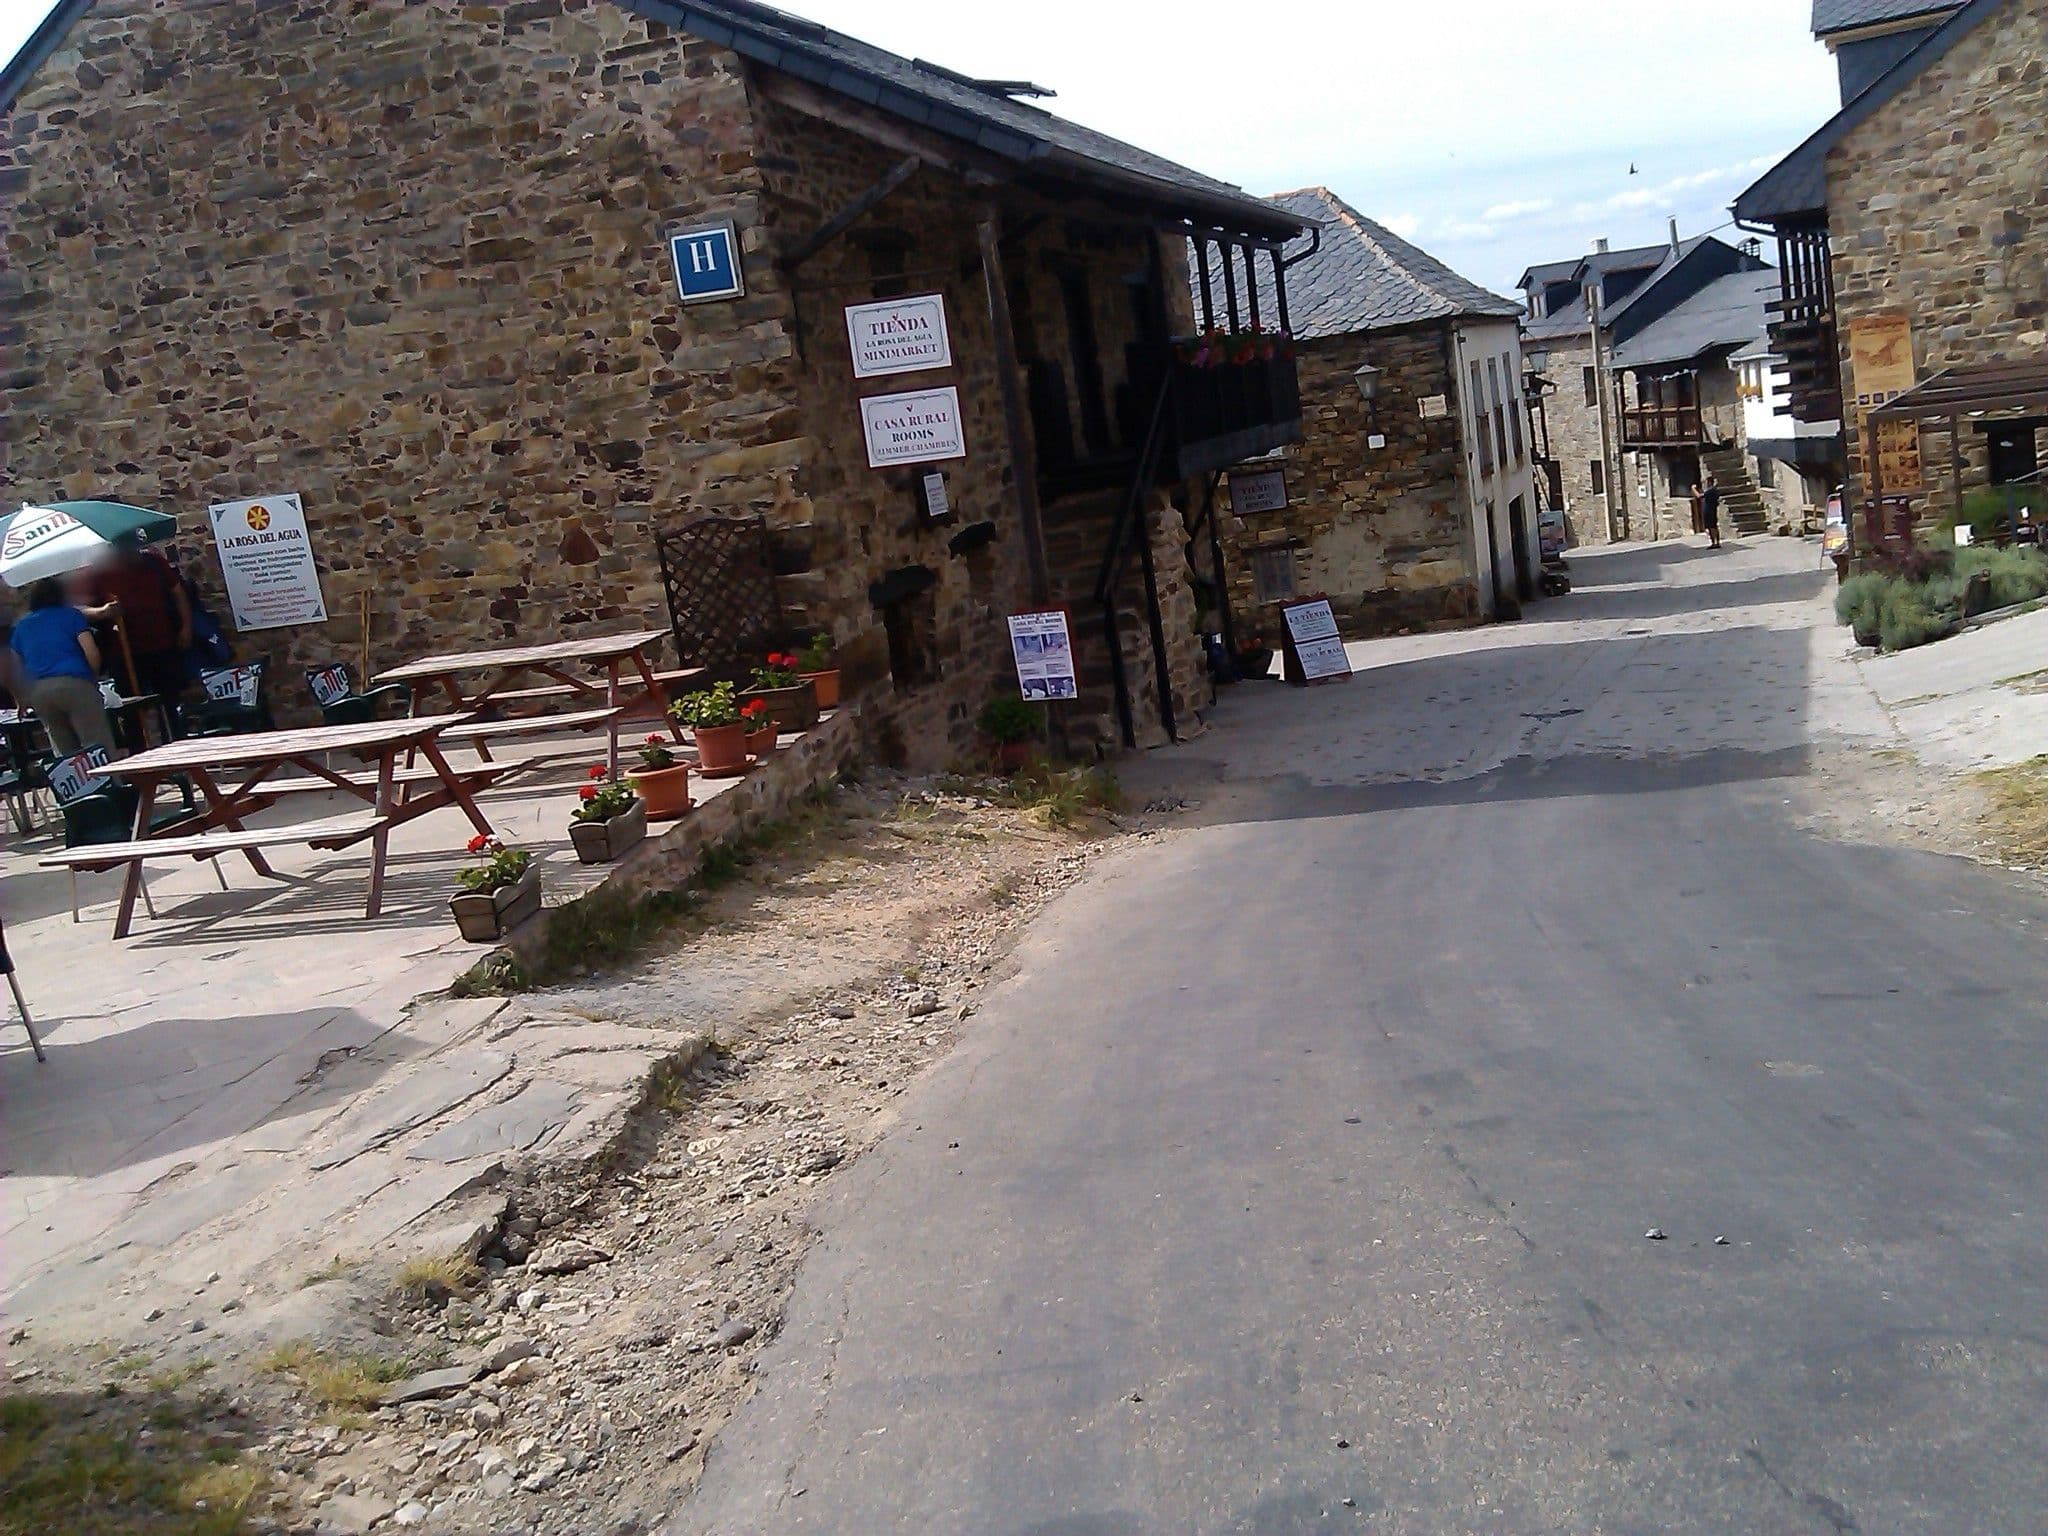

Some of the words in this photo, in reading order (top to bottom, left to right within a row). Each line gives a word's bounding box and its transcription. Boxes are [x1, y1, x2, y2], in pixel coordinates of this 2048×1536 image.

[688, 239, 717, 273] H
[869, 316, 928, 336] TIENDA
[866, 340, 877, 348] LA
[877, 337, 897, 347] ROSA
[897, 335, 912, 344] DEL
[864, 343, 938, 361] MINIMARKET
[874, 417, 906, 431] CASA
[909, 411, 950, 427] RURAL
[892, 428, 935, 443] ROOMS
[5, 524, 51, 560] San
[222, 537, 234, 549] LA
[236, 533, 259, 548] ROSA
[260, 531, 277, 545] DEL
[278, 529, 302, 541] AGUA
